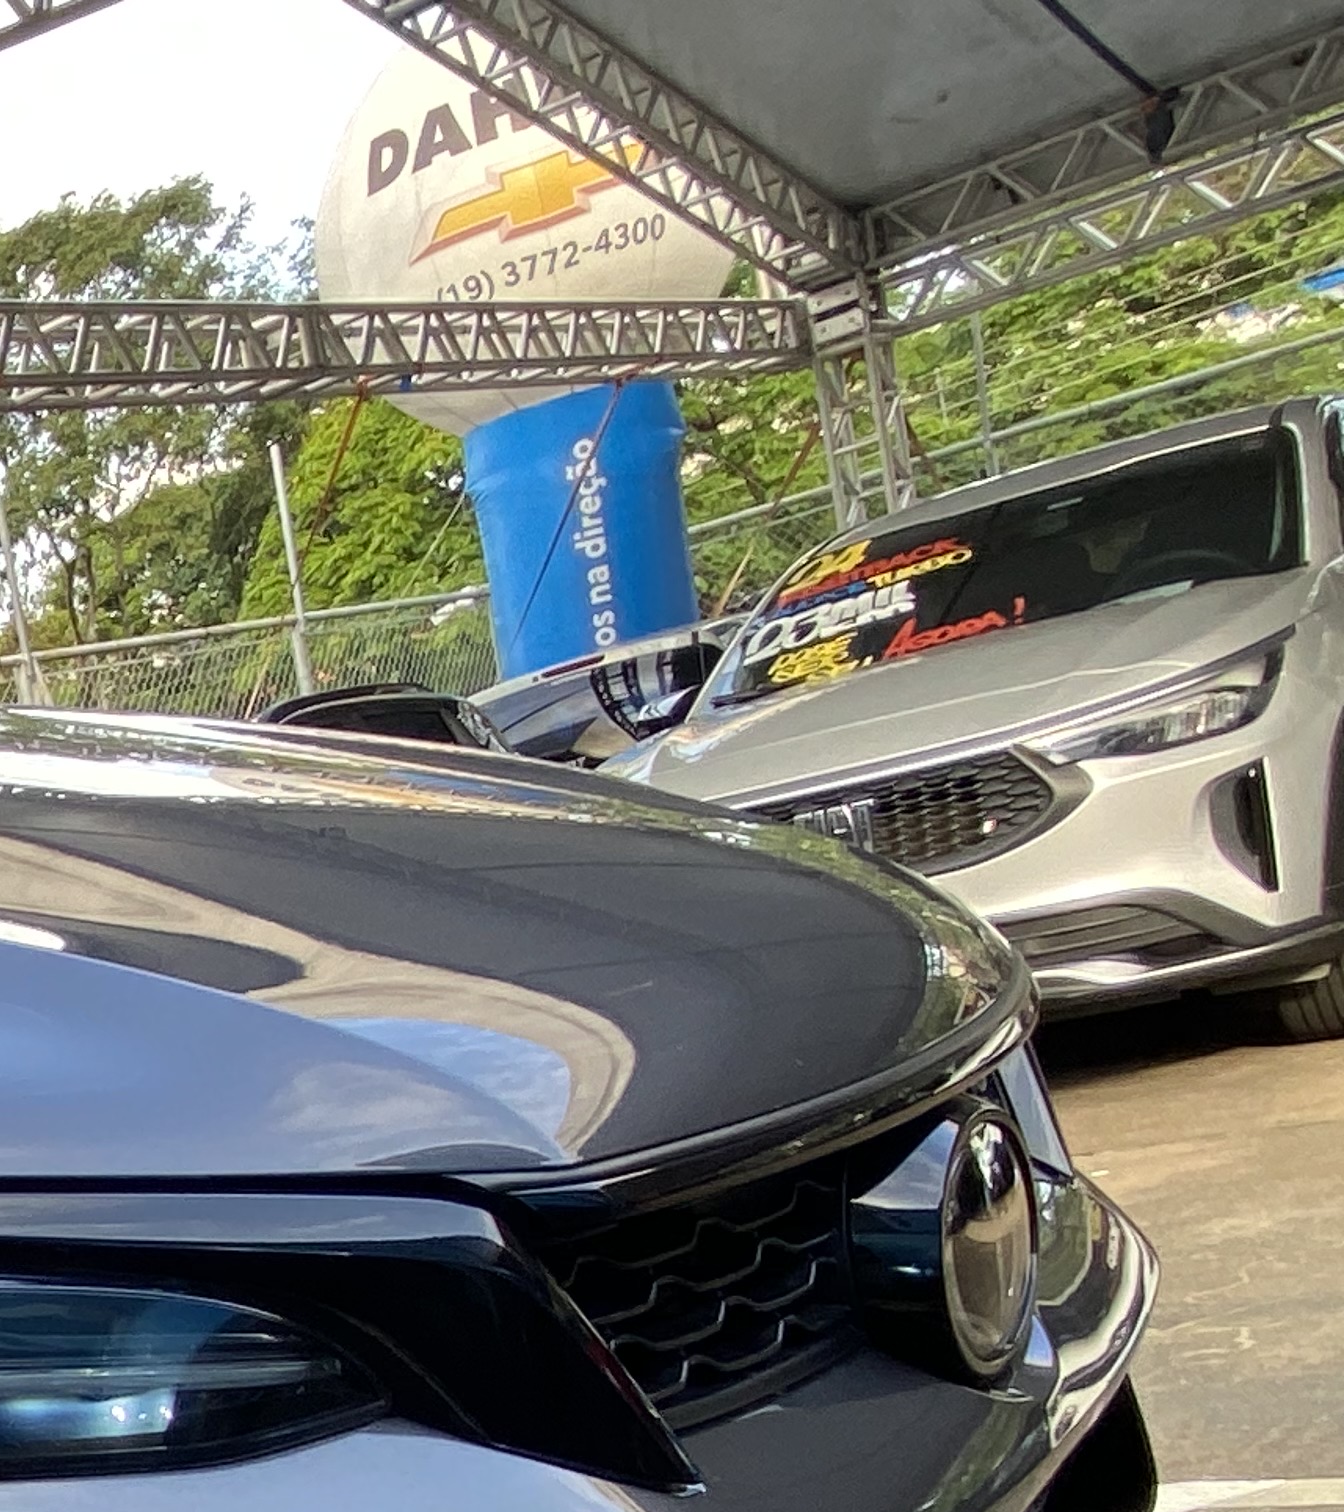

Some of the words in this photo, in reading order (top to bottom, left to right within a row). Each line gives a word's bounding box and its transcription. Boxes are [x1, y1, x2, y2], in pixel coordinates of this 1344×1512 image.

[500, 213, 667, 289] 3772-4300
[566, 437, 608, 559] direção
[587, 563, 613, 606] na
